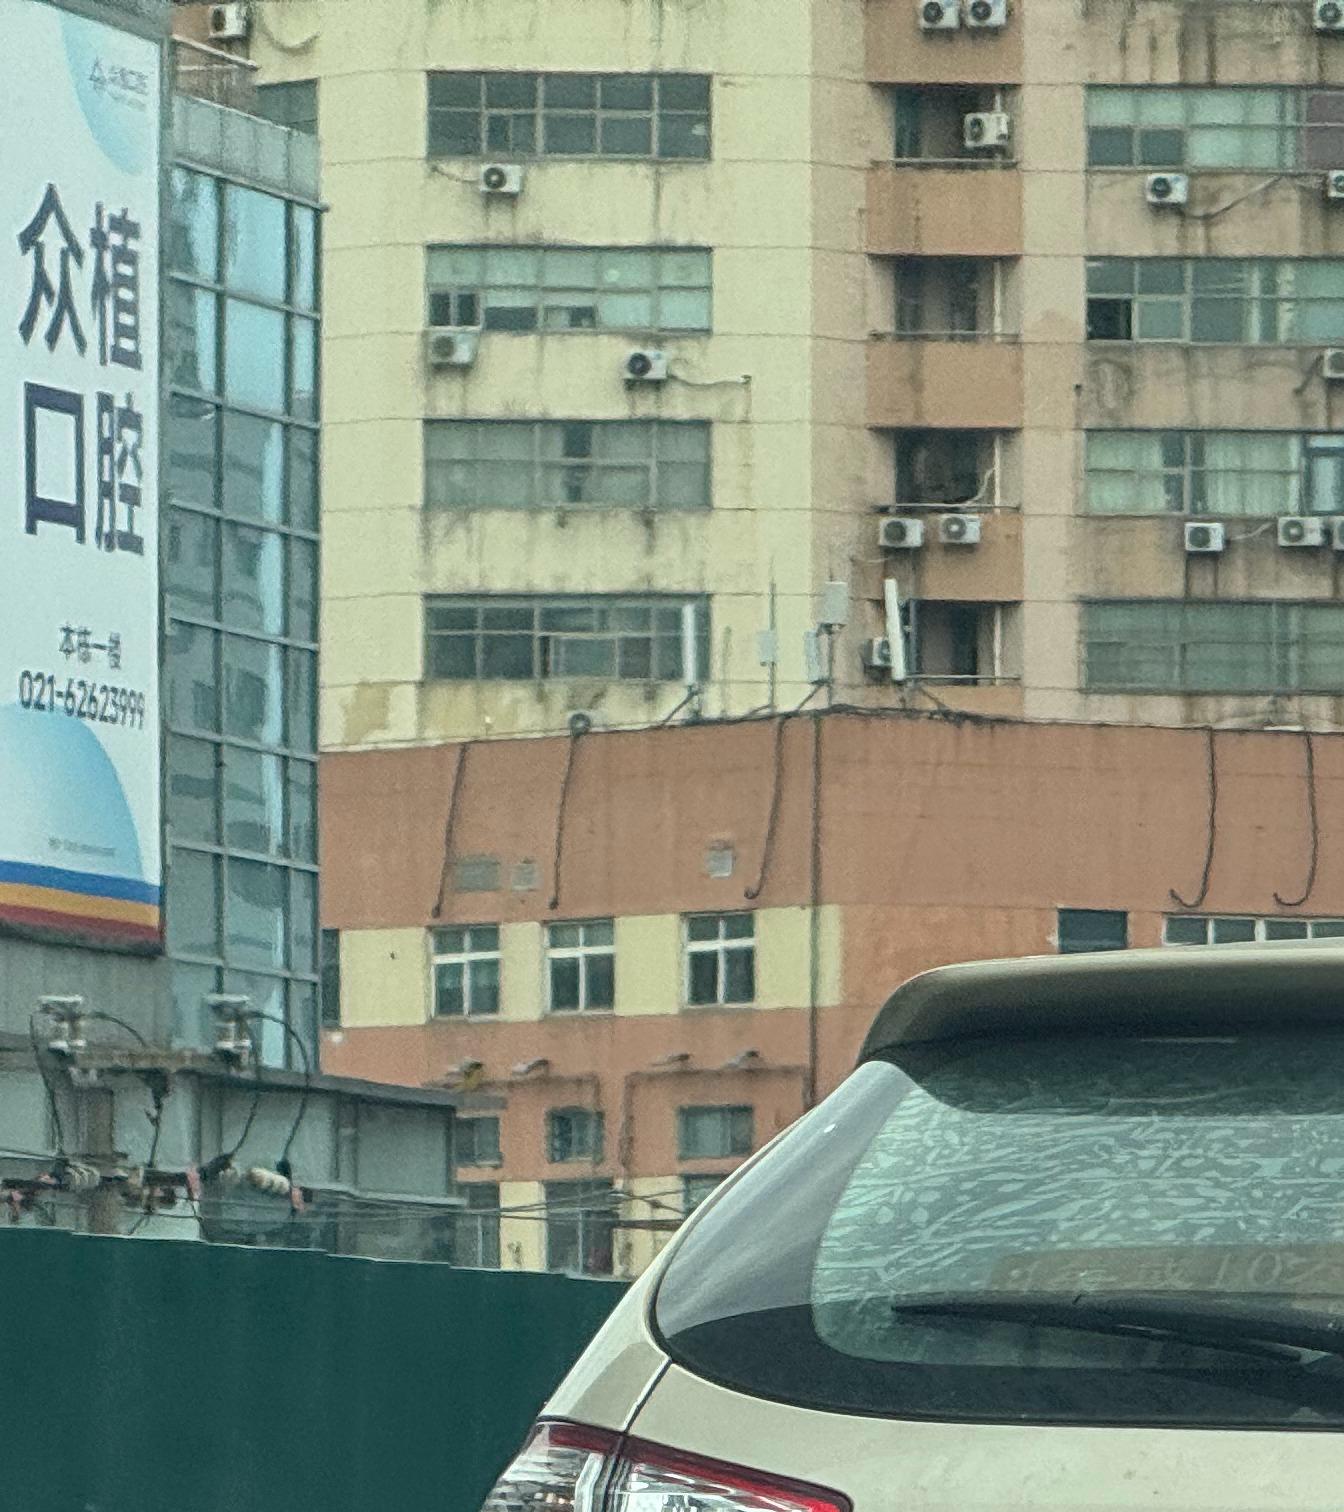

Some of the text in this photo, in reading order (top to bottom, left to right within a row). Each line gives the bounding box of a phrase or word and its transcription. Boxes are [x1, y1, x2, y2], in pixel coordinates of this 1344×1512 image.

[17, 182, 142, 370] 众植
[23, 380, 145, 556] 口腔
[20, 670, 145, 730] 021-62623999
